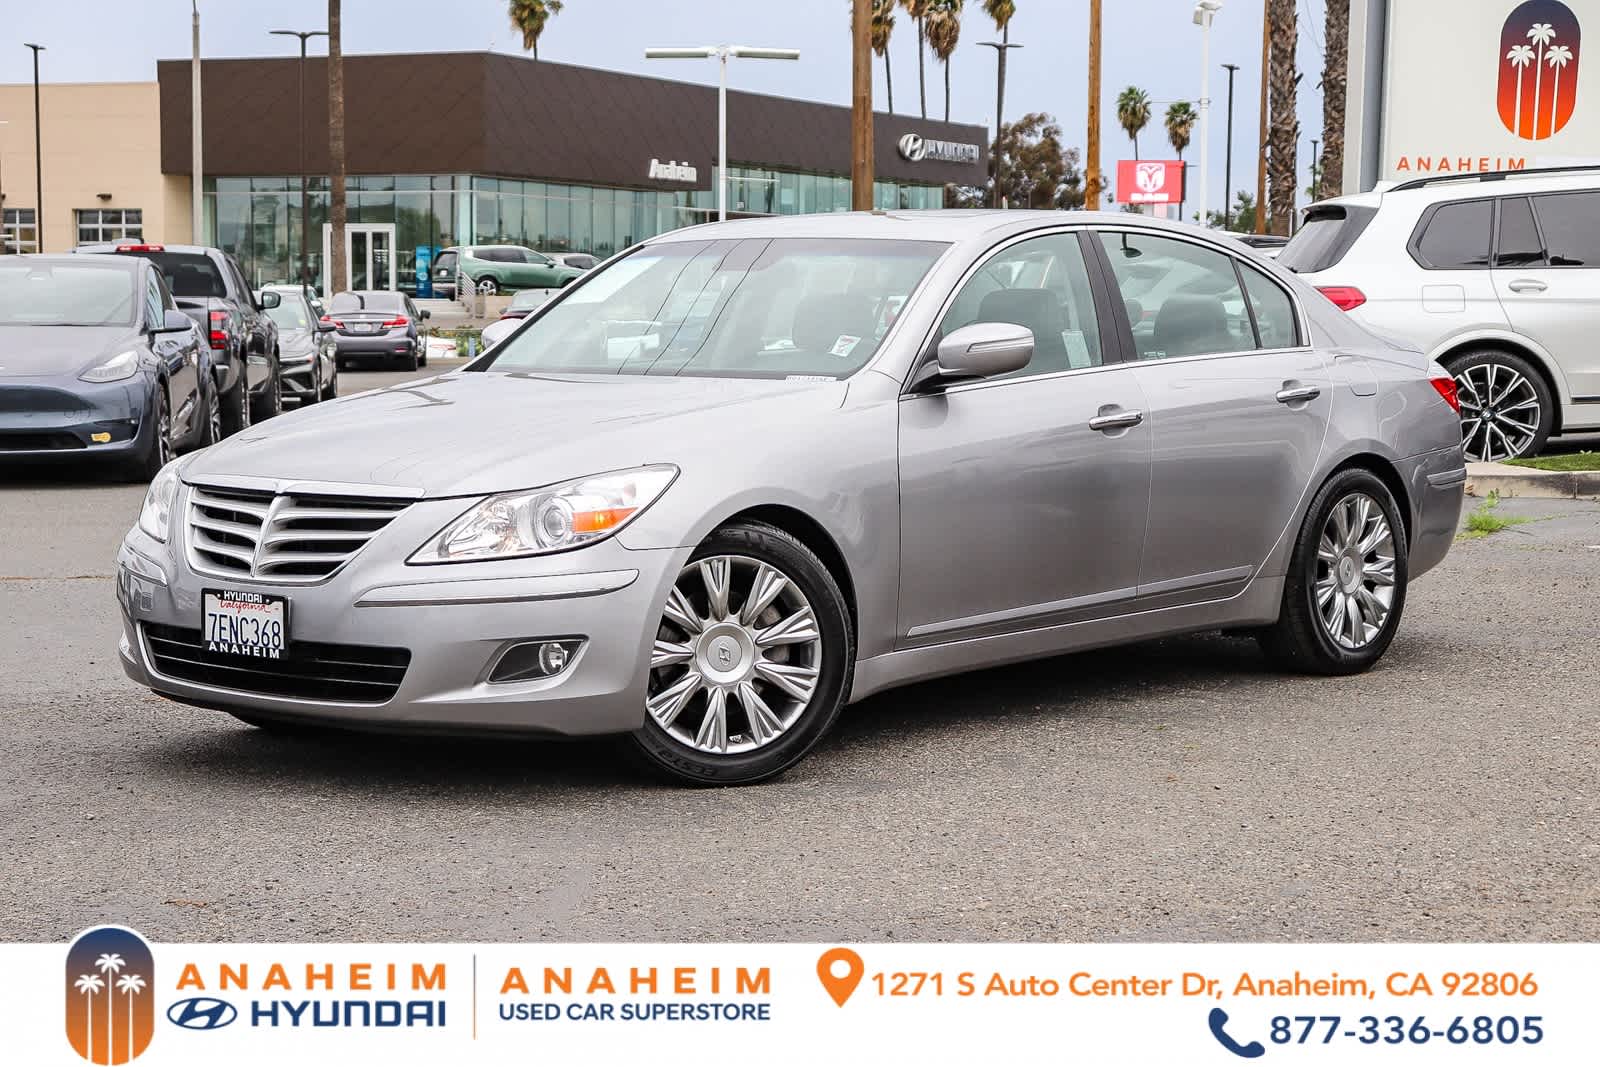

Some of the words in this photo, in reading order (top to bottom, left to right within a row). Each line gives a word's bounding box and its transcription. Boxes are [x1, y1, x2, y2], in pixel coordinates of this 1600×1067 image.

[648, 158, 697, 182] Anaheim
[1397, 156, 1526, 172] ANAHEIM
[223, 591, 262, 603] HYUNDAI
[219, 599, 271, 613] California
[208, 613, 281, 648] 7ENC368
[208, 641, 280, 659] ANAHEIM
